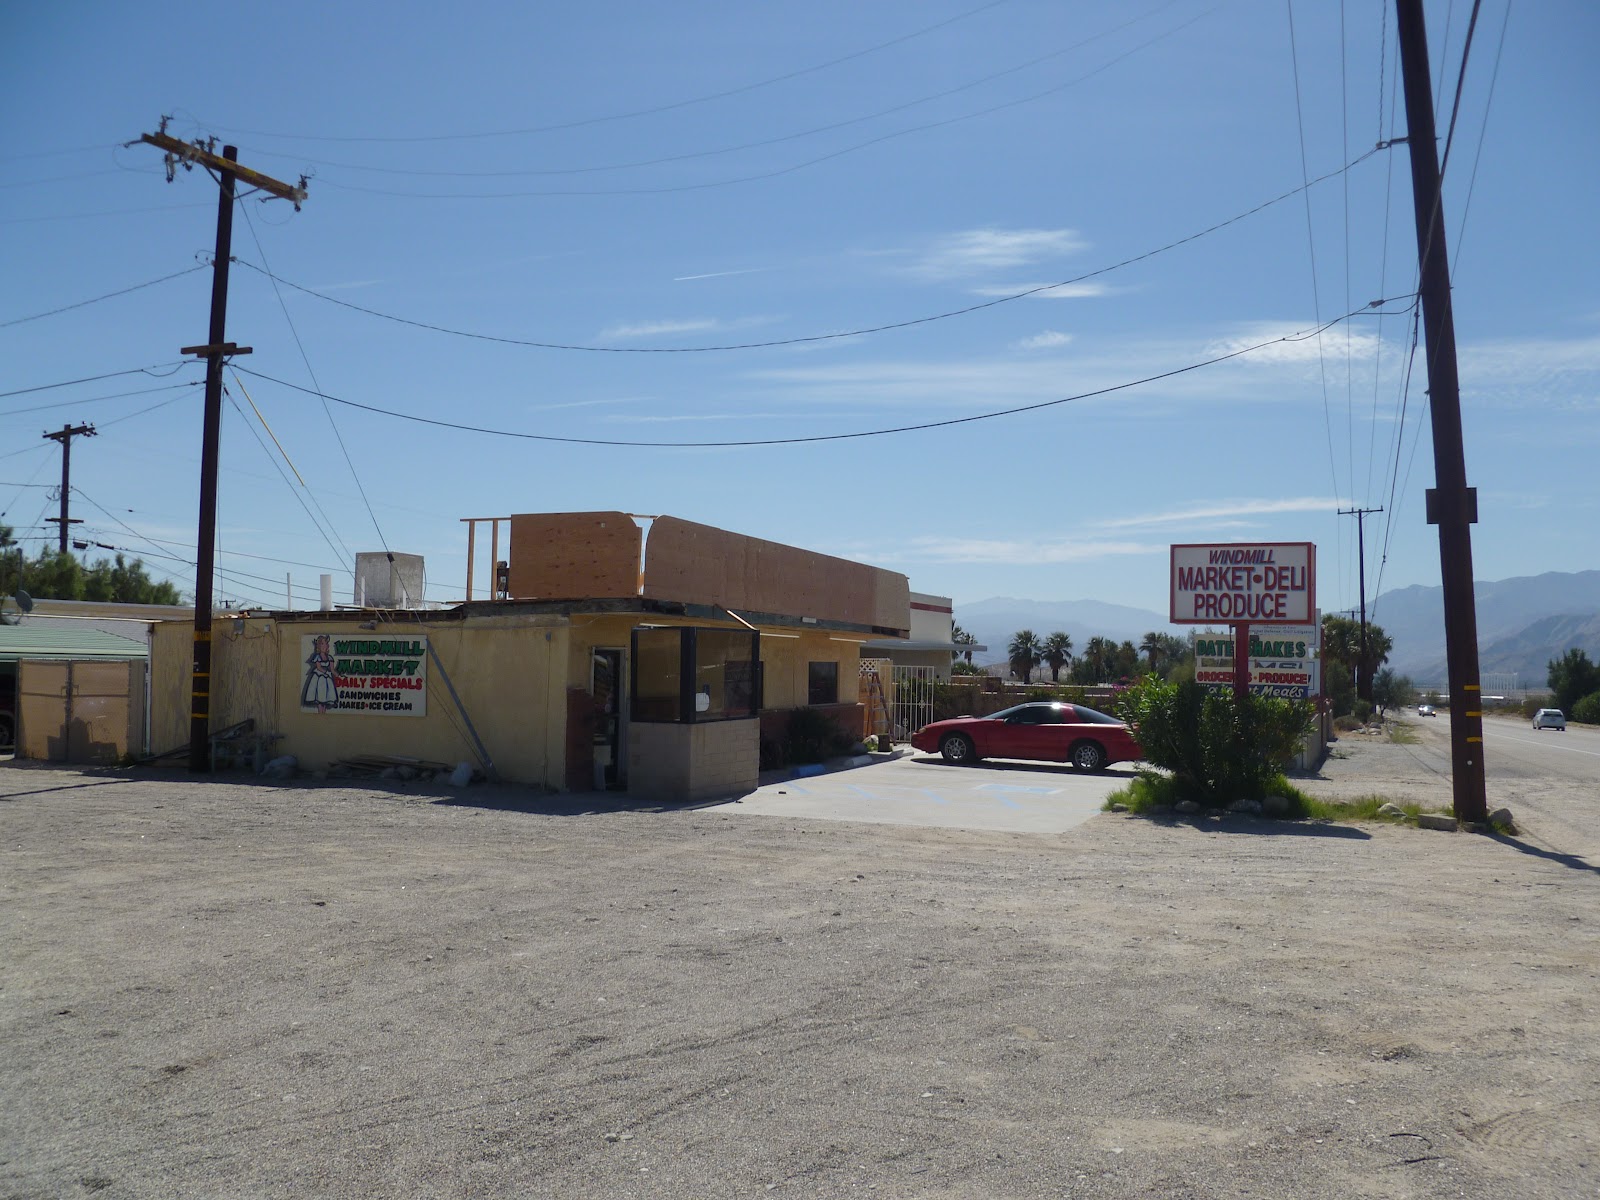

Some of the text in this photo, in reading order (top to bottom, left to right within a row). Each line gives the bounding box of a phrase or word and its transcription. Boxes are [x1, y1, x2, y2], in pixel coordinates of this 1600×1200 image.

[1209, 549, 1275, 564] WINDMILL
[1178, 566, 1305, 591] MARKET DELI
[1194, 593, 1287, 618] PRODUCE
[334, 640, 425, 655] WINDMILL
[1197, 640, 1306, 657] DATE SHAKES
[337, 659, 419, 675] MARKET
[334, 676, 423, 690] DAILY SPECIALS
[1197, 671, 1308, 684] GROCES PRODUCE
[339, 690, 401, 701] SANDWICHES
[1260, 685, 1304, 698] Meals
[383, 702, 413, 711] CREAM
